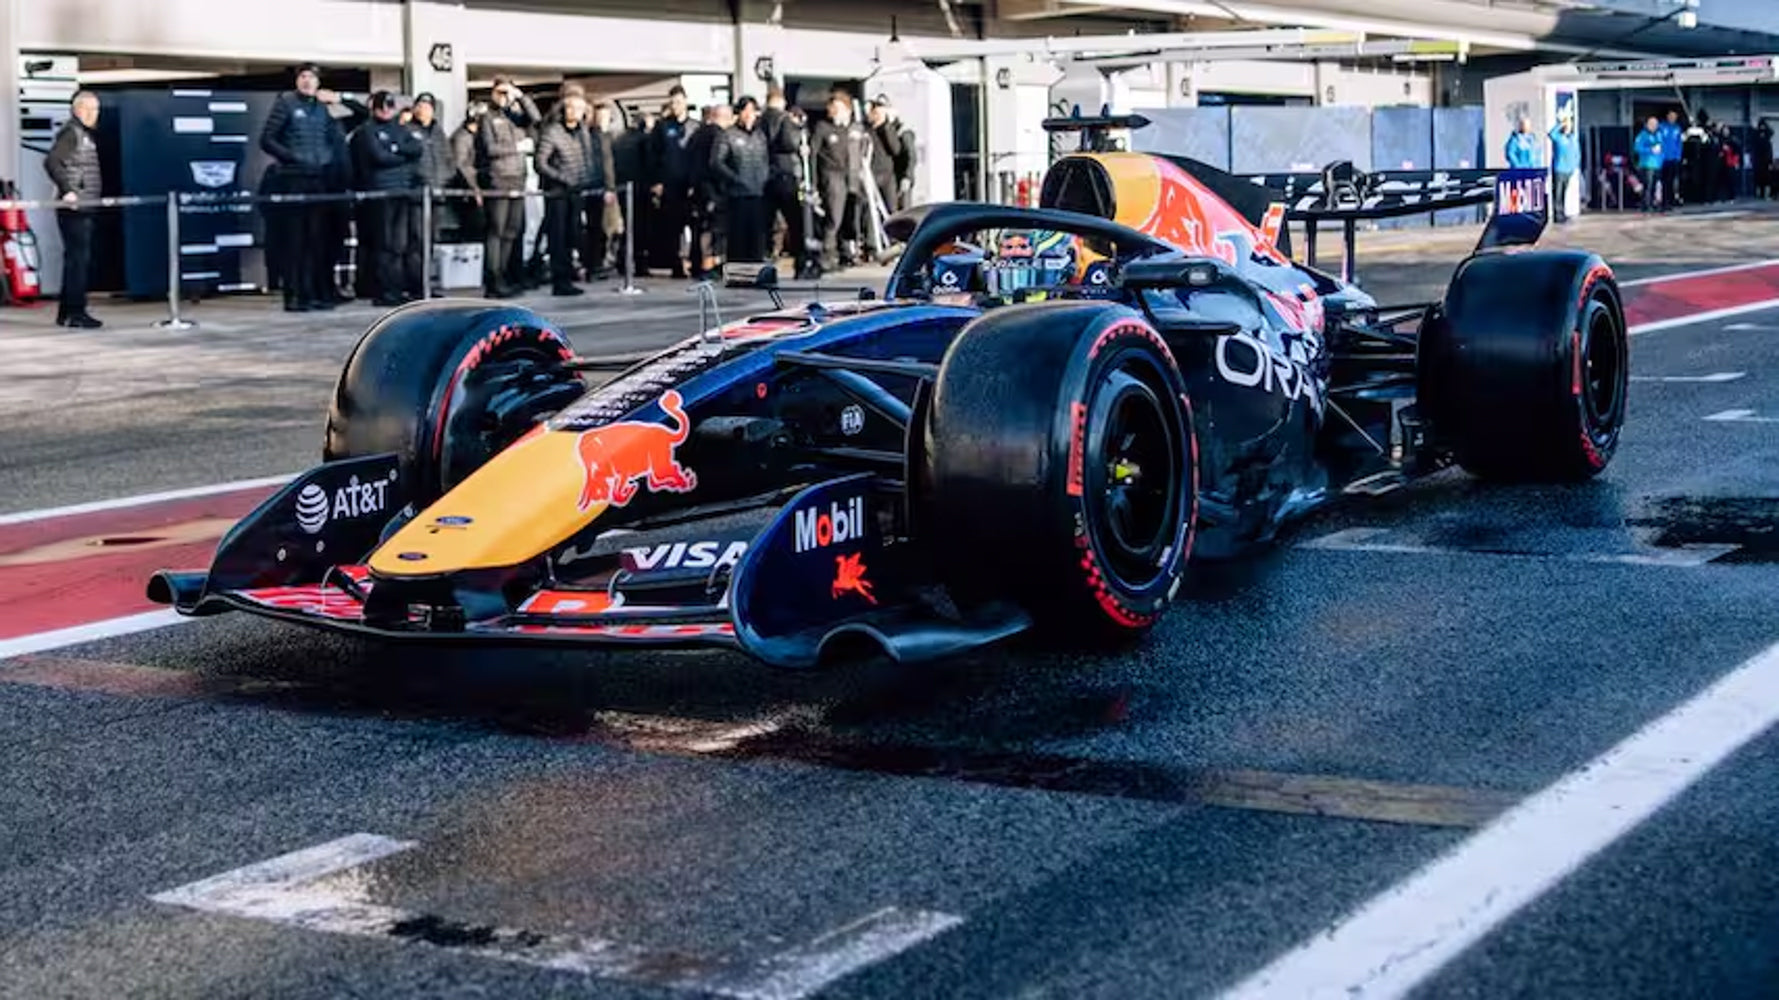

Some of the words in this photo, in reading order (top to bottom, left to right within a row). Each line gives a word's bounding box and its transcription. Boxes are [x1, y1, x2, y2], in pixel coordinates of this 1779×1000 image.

[1499, 179, 1531, 215] Mobil
[842, 409, 864, 431] FIA
[332, 480, 388, 519] AT&T
[795, 496, 863, 552] Mobil
[622, 541, 748, 570] VISA
